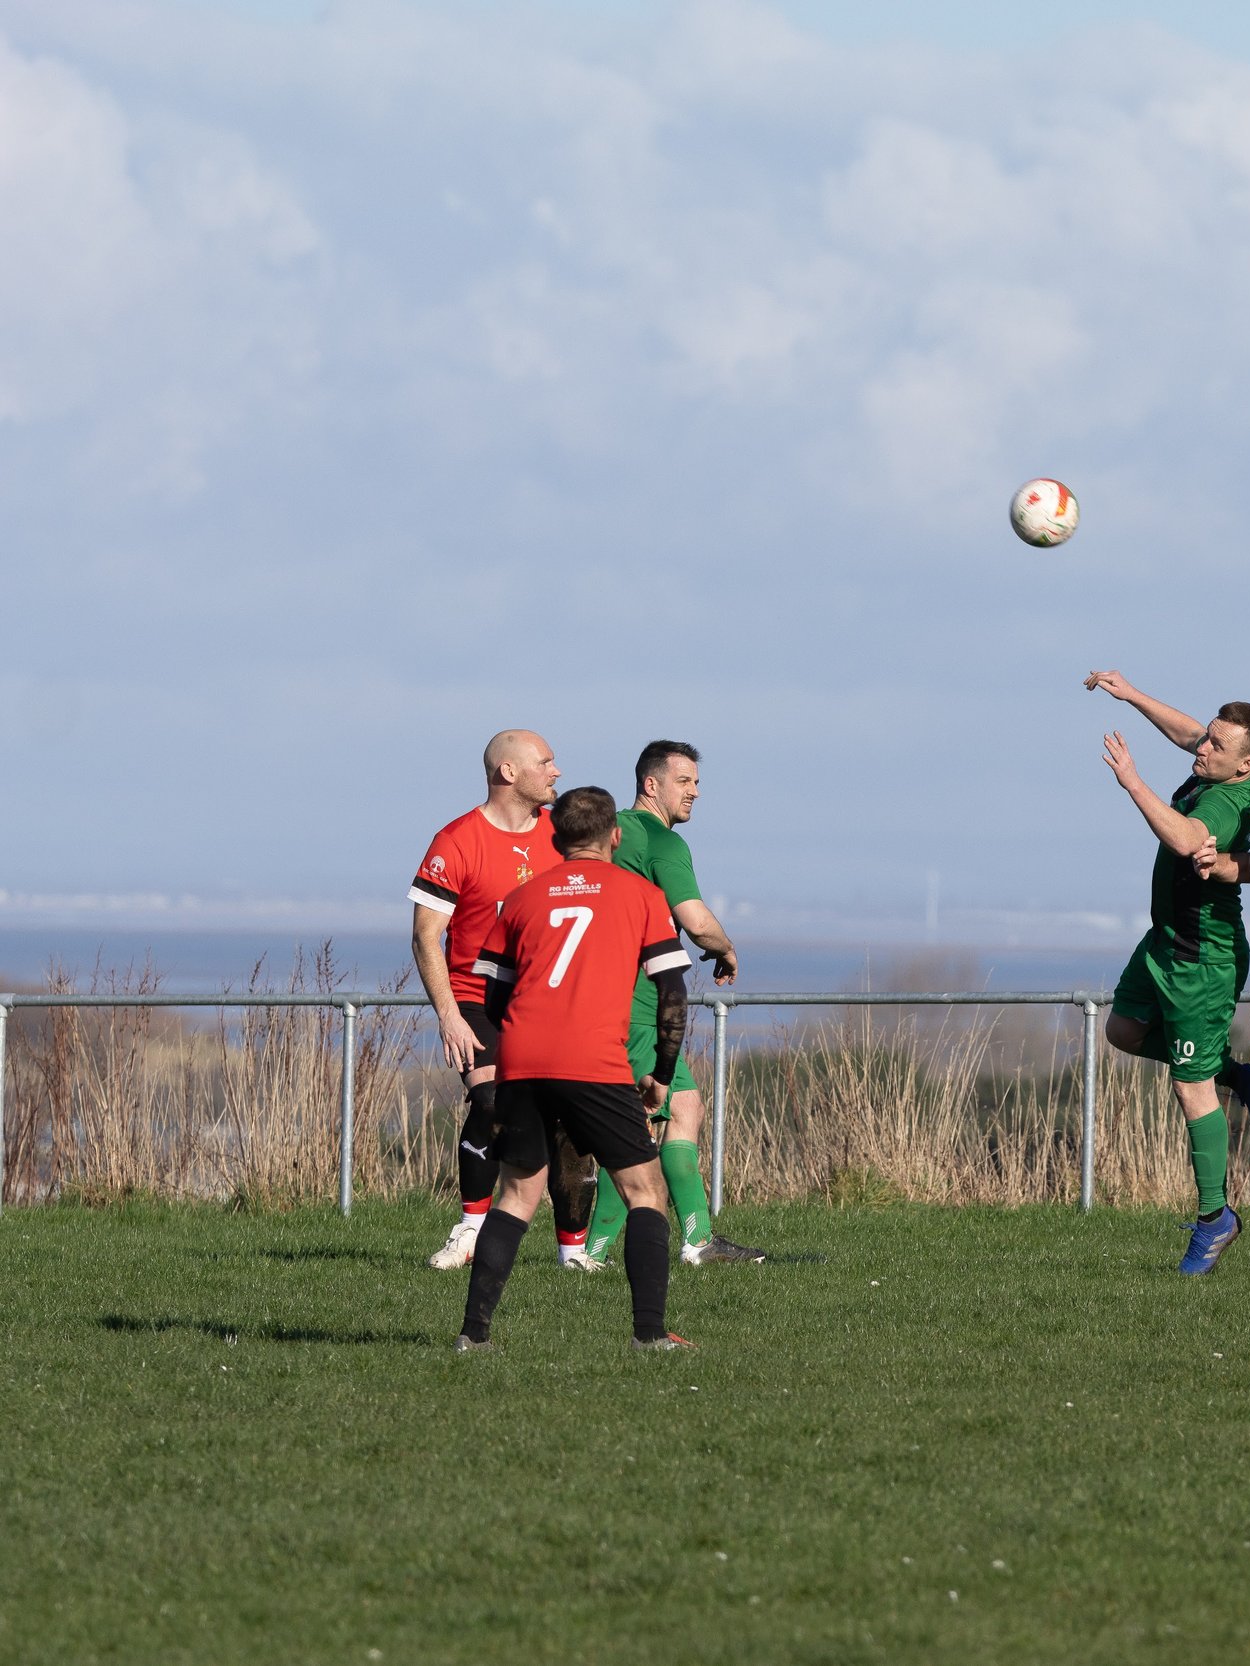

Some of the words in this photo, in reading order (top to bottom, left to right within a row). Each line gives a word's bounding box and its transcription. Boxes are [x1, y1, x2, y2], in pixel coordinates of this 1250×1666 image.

[562, 883, 602, 892] HOWELLS
[549, 906, 593, 988] 7
[1174, 1038, 1195, 1057] 10
